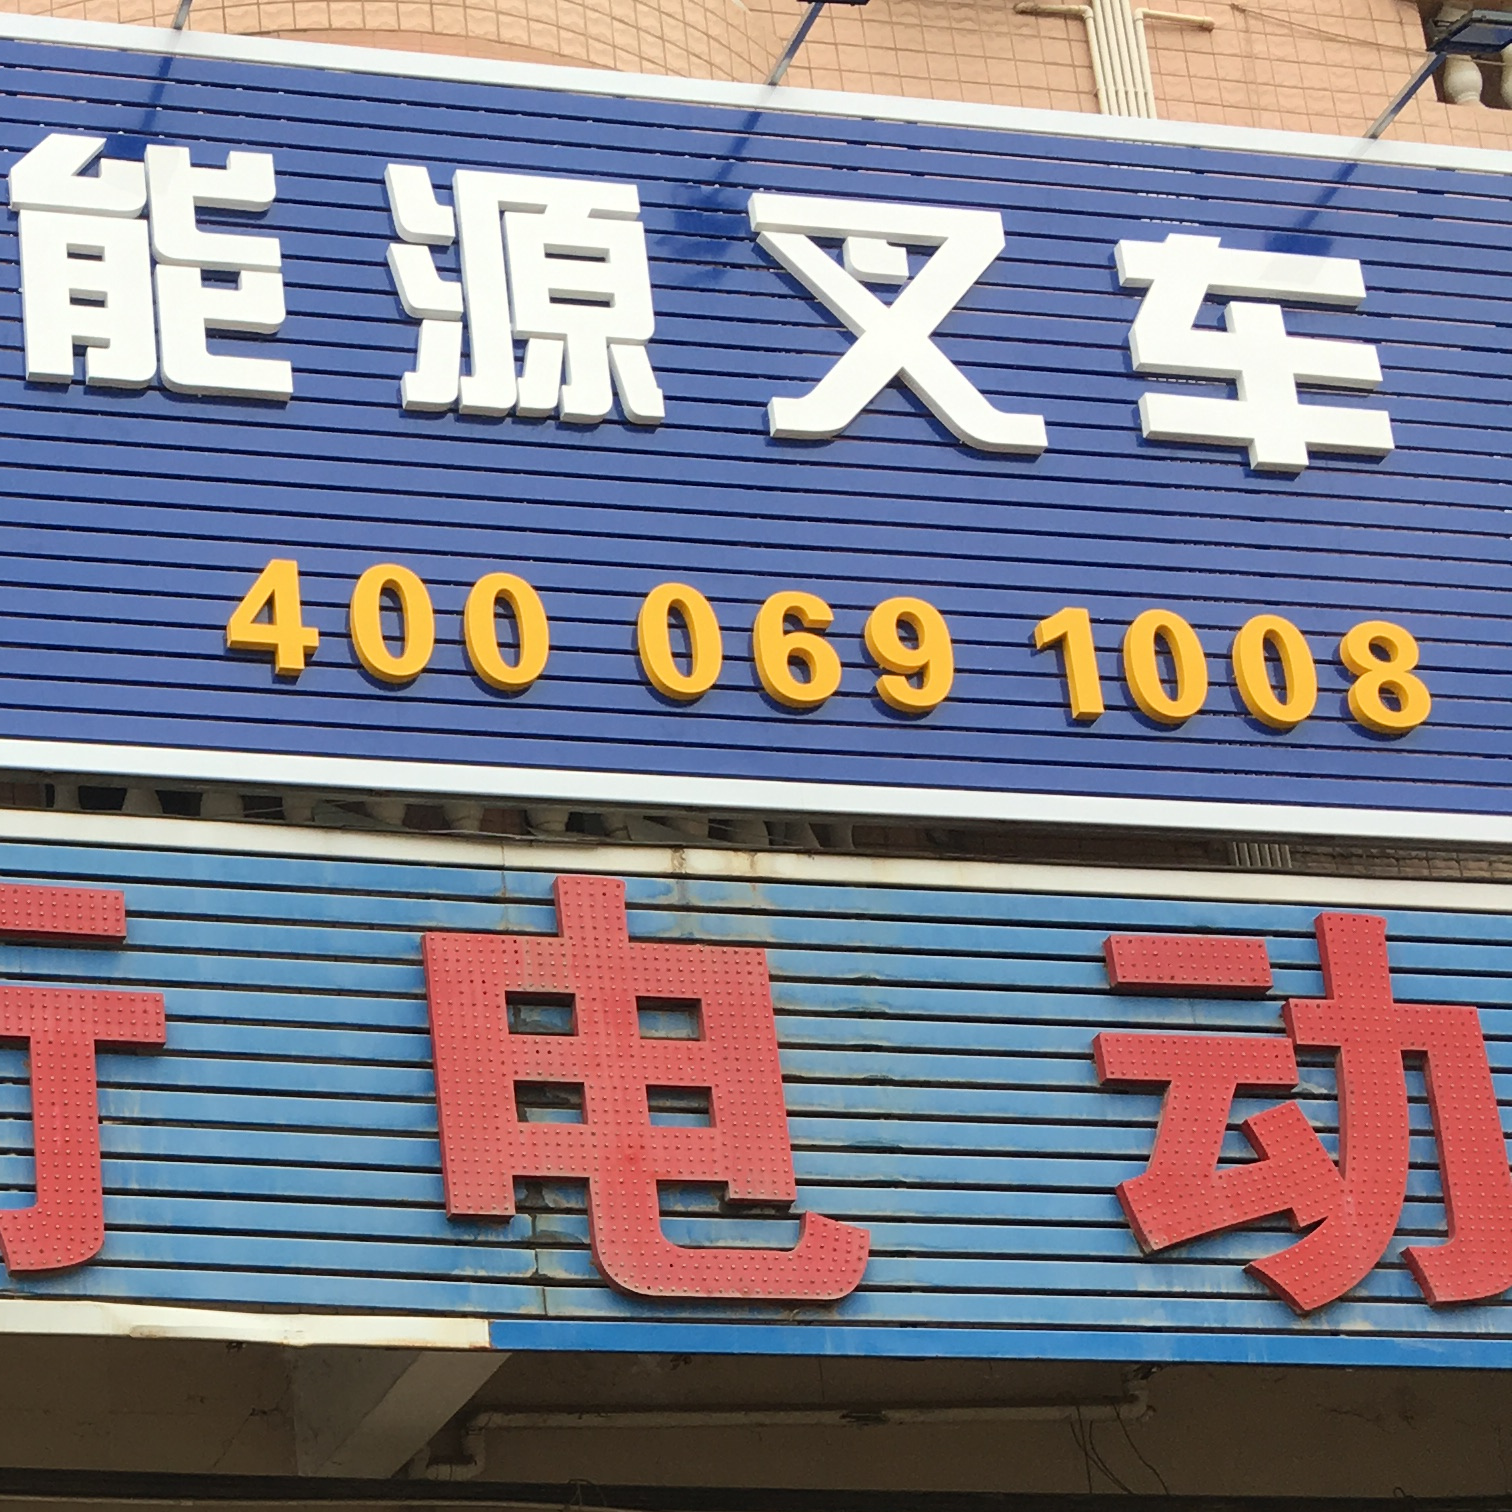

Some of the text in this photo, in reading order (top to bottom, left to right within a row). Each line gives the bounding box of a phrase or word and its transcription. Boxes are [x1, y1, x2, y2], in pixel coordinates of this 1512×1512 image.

[225, 558, 1432, 735] 400 069 1008
